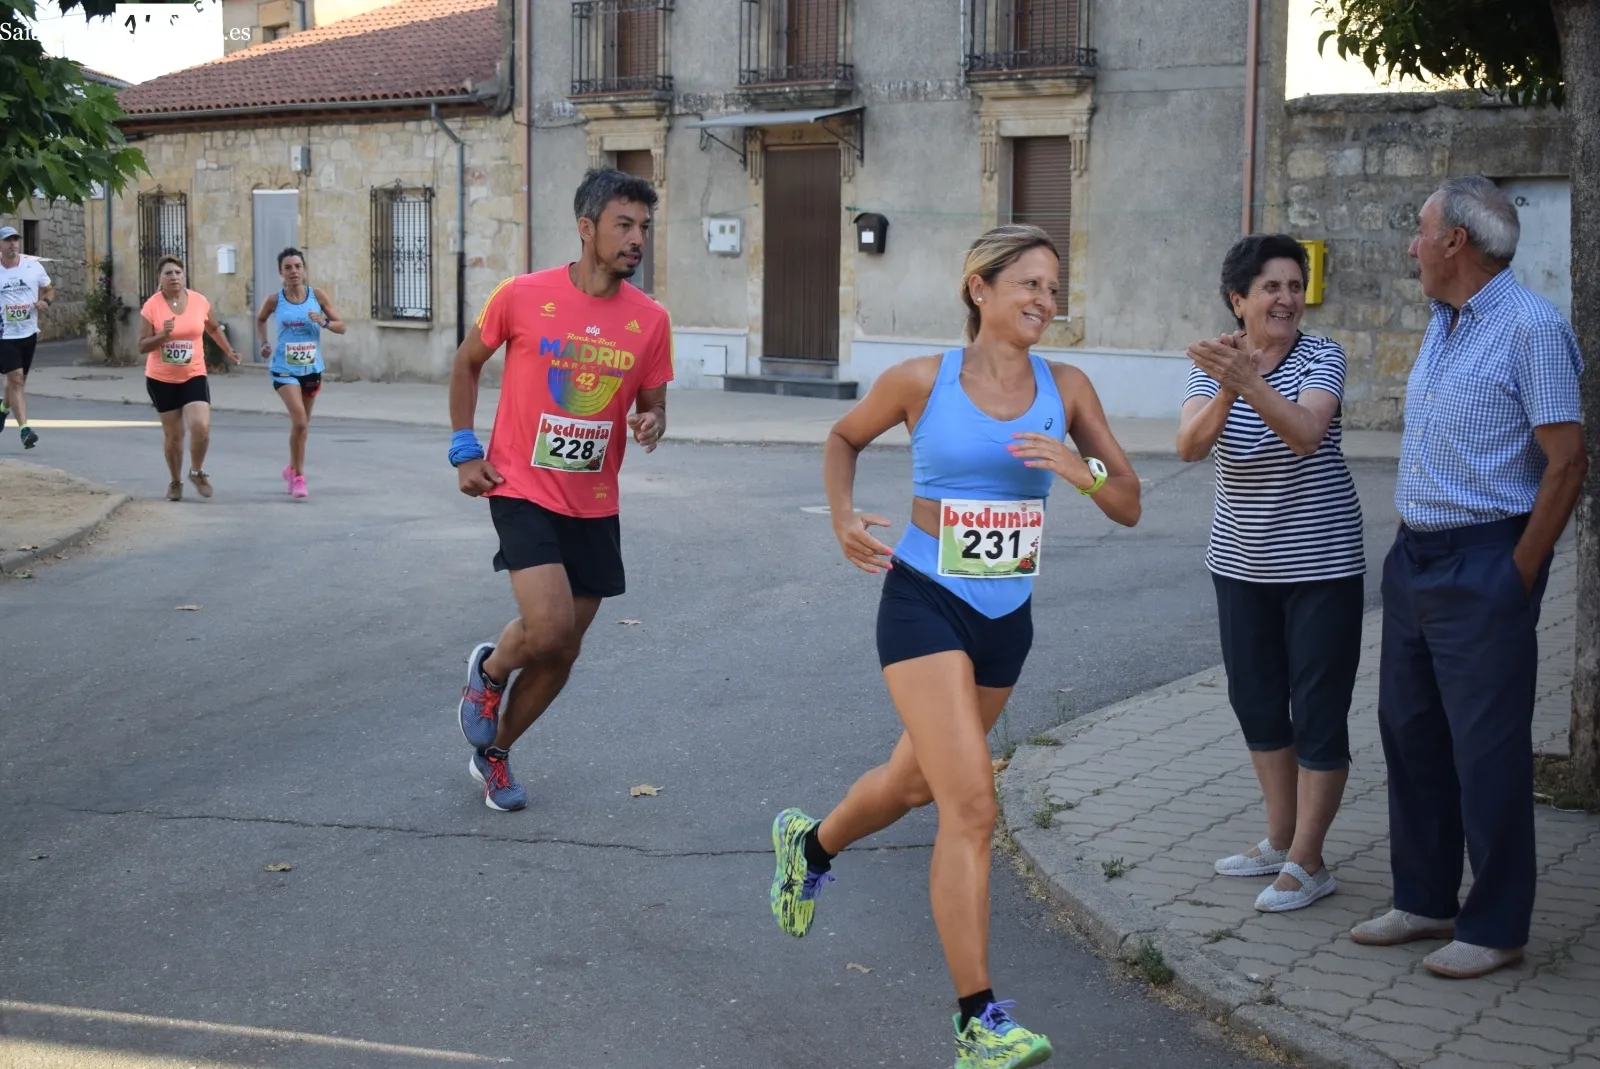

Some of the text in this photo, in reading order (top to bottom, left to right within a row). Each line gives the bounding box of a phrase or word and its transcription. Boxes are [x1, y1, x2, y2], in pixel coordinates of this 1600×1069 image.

[10, 309, 27, 318] 209
[586, 326, 600, 336] edp
[166, 349, 187, 359] 207
[292, 351, 311, 361] 224
[540, 336, 635, 371] MADRID
[576, 372, 596, 386] 42
[540, 418, 610, 440] bedunia
[549, 437, 595, 460] 228
[944, 506, 1041, 528] bedunia
[961, 529, 1021, 560] 231
